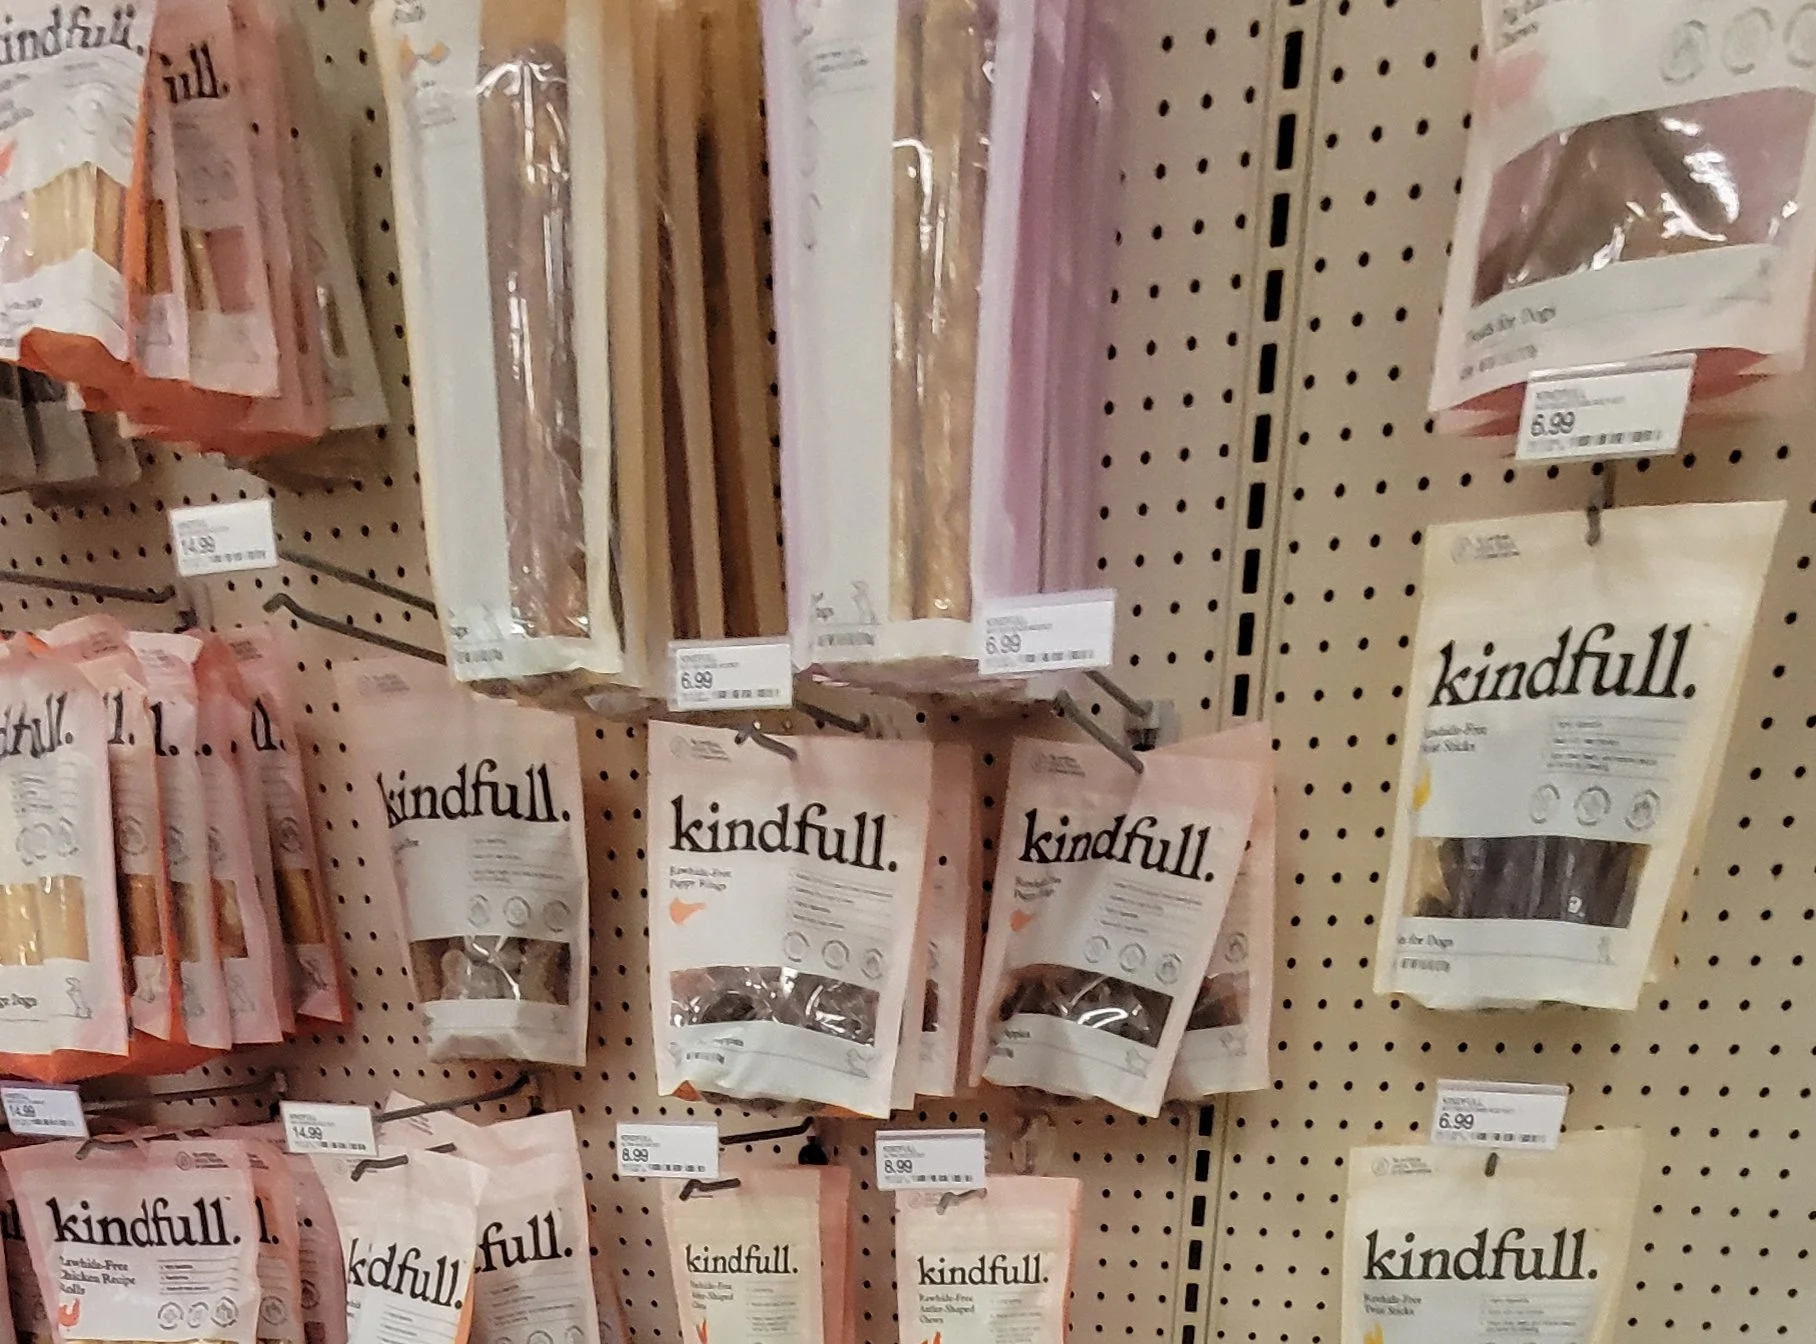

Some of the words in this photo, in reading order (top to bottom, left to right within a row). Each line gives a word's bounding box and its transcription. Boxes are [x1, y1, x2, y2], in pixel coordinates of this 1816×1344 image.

[985, 633, 1022, 655] 6.99
[681, 671, 713, 690] 6.99
[1427, 622, 1697, 707] kindfull.
[376, 758, 571, 828] kindfull.
[669, 794, 898, 872] kindfull.
[1018, 807, 1215, 882] kindfull.
[292, 1125, 323, 1140] 14.99
[1438, 1112, 1474, 1130] 6.99
[621, 1148, 649, 1163] 8.99
[884, 1158, 913, 1174] 8.99
[45, 1196, 241, 1248] kindfull.
[474, 1210, 572, 1274] full.
[1363, 1227, 1598, 1281] kindfull.
[348, 1237, 463, 1309] kdfull.
[685, 1243, 798, 1274] kindfull.
[916, 1253, 1049, 1285] kindfull.
[103, 1273, 136, 1287] Recipe
